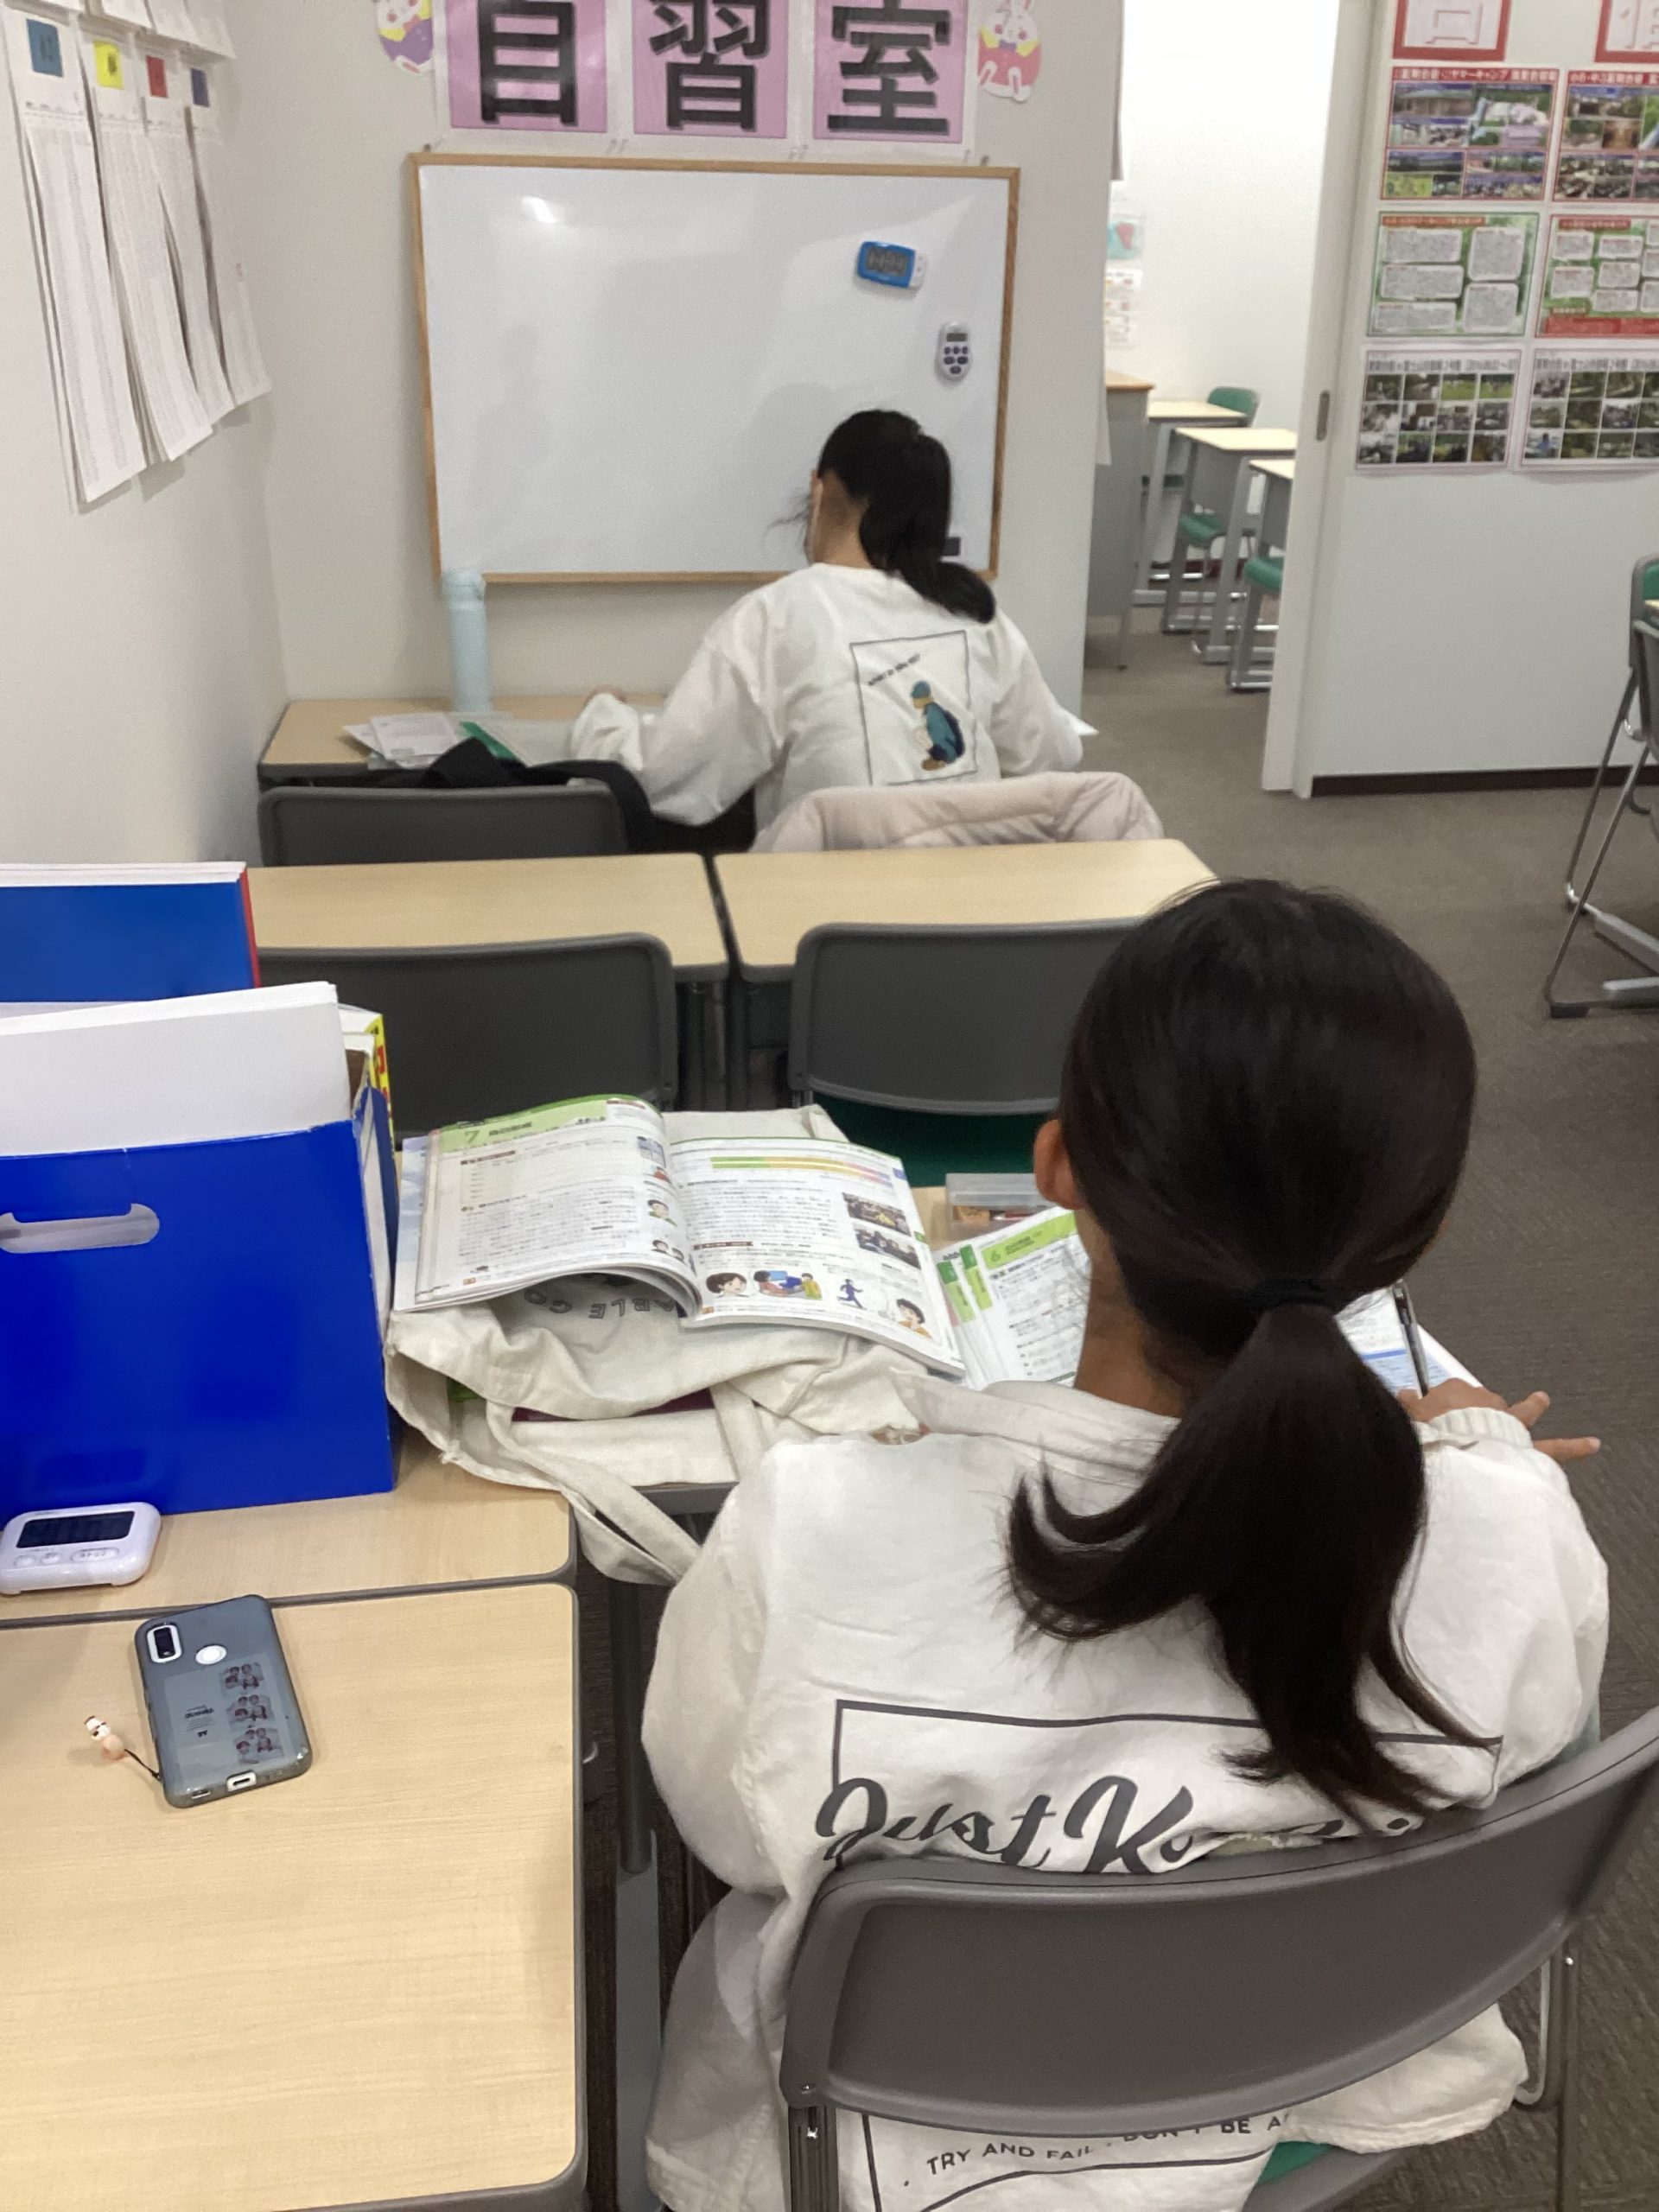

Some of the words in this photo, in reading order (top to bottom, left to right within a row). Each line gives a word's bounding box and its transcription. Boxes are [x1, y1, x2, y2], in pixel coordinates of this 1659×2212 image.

[815, 1777, 1057, 1868] Just
[926, 2148, 971, 2175] TRY
[982, 2142, 1035, 2158] AND
[1220, 2118, 1252, 2134] BE
